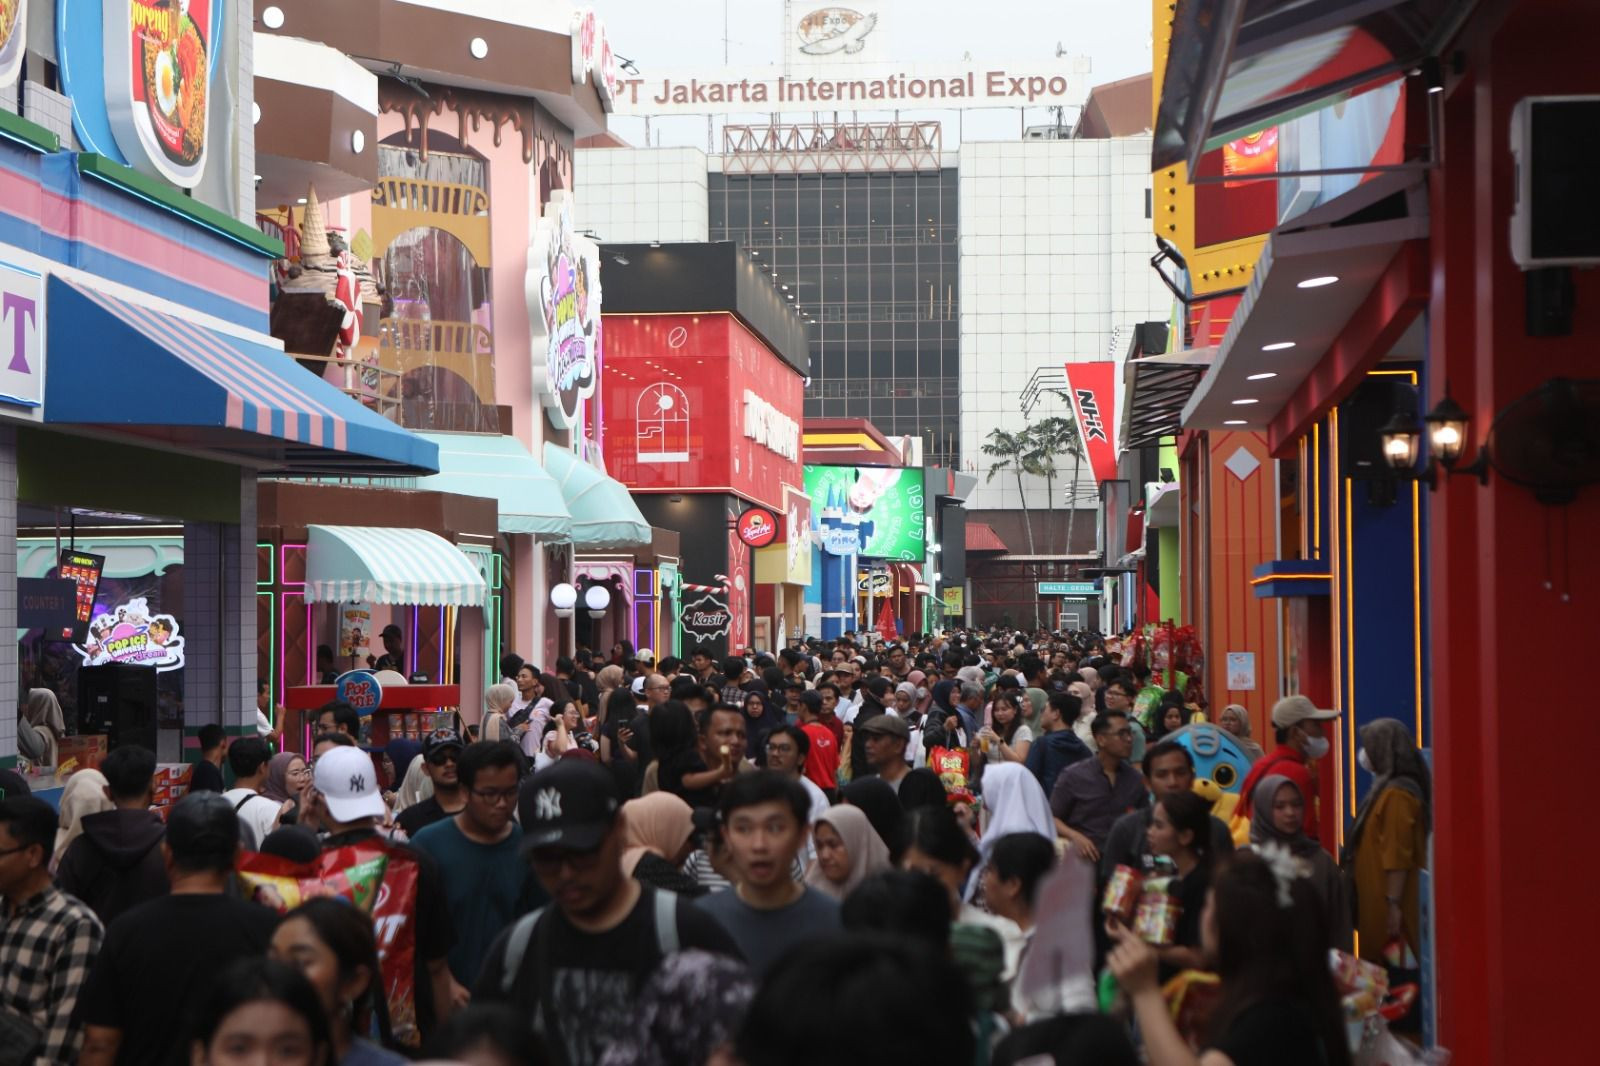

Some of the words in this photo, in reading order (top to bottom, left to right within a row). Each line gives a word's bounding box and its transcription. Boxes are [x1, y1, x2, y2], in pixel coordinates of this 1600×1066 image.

[654, 77, 769, 105] Jakarta
[778, 72, 975, 102] International
[986, 71, 1068, 103] Expo
[1076, 388, 1107, 443] NHK
[692, 611, 728, 627] Kasir
[107, 639, 130, 653] POP
[130, 634, 147, 647] ICE
[344, 681, 371, 696] POP
